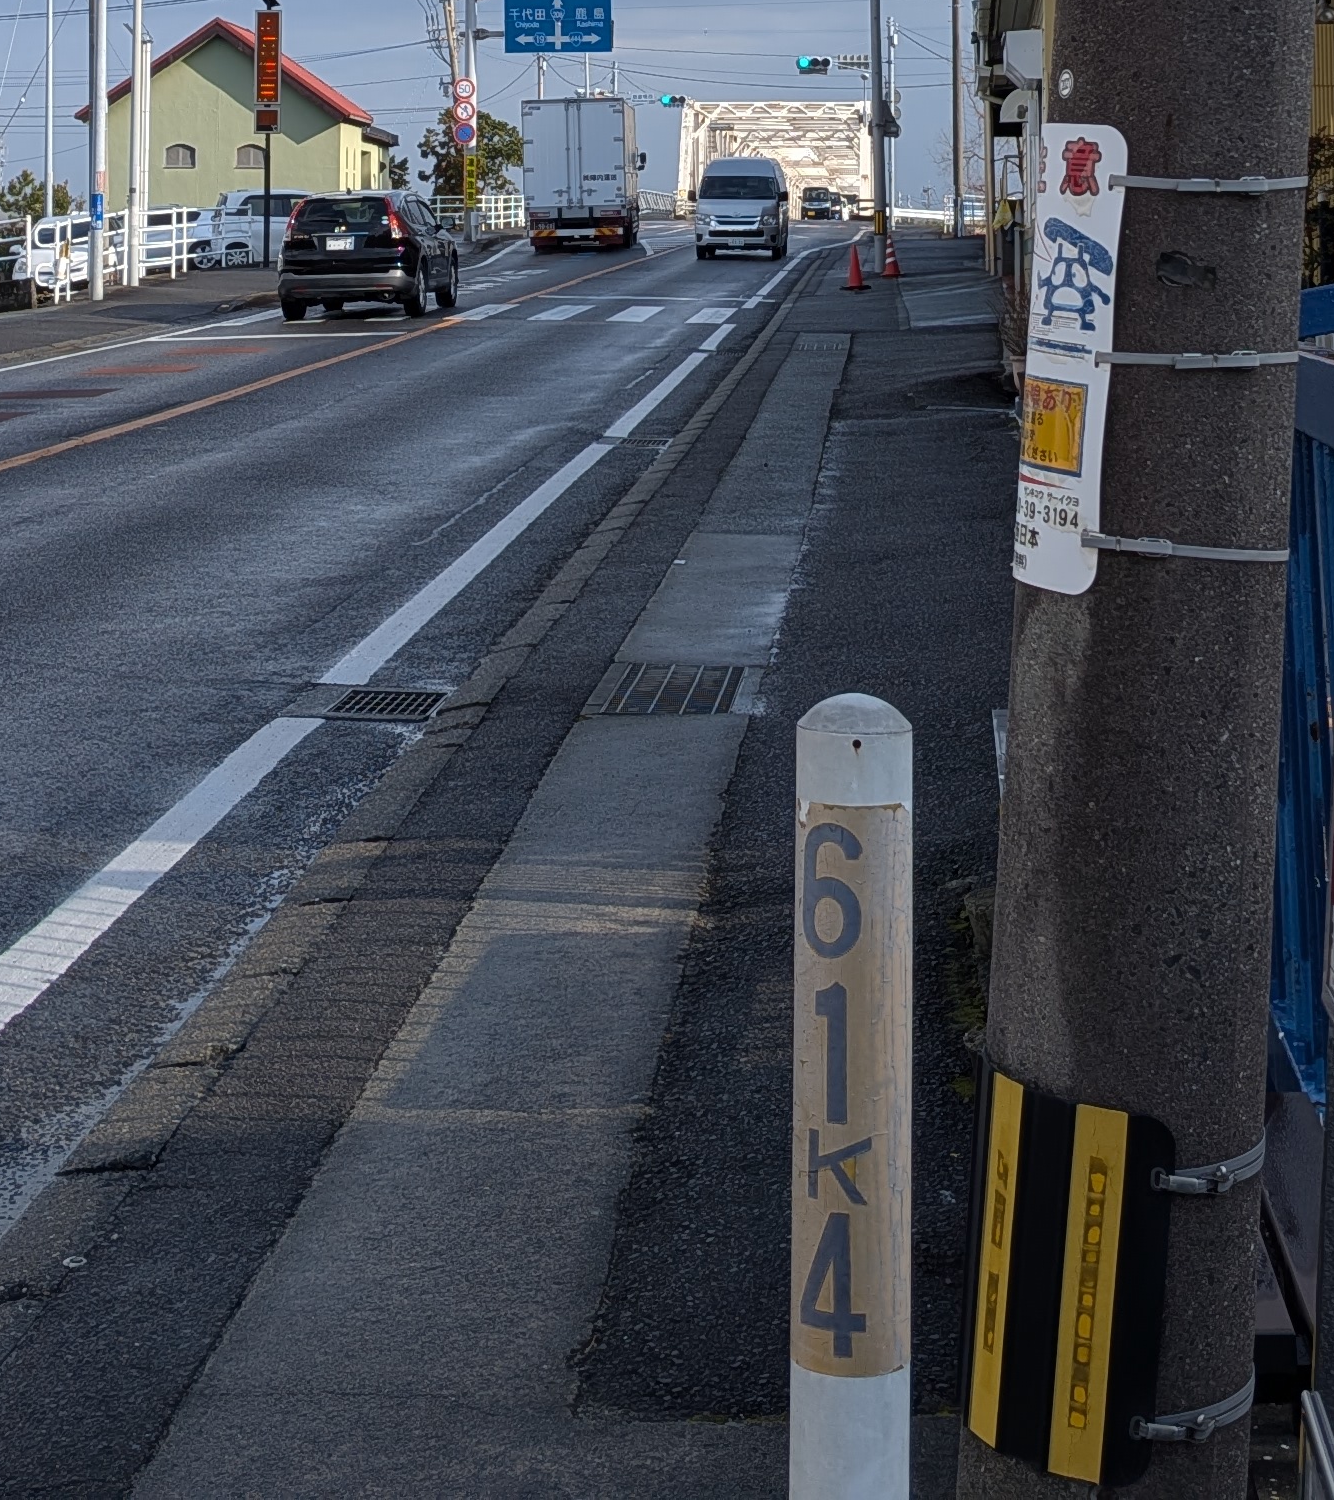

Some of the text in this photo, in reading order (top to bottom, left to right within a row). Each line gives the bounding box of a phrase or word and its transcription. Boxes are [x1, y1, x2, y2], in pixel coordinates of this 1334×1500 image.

[508, 8, 546, 21] 千代田
[536, 35, 545, 44] 19
[458, 84, 471, 94] 50
